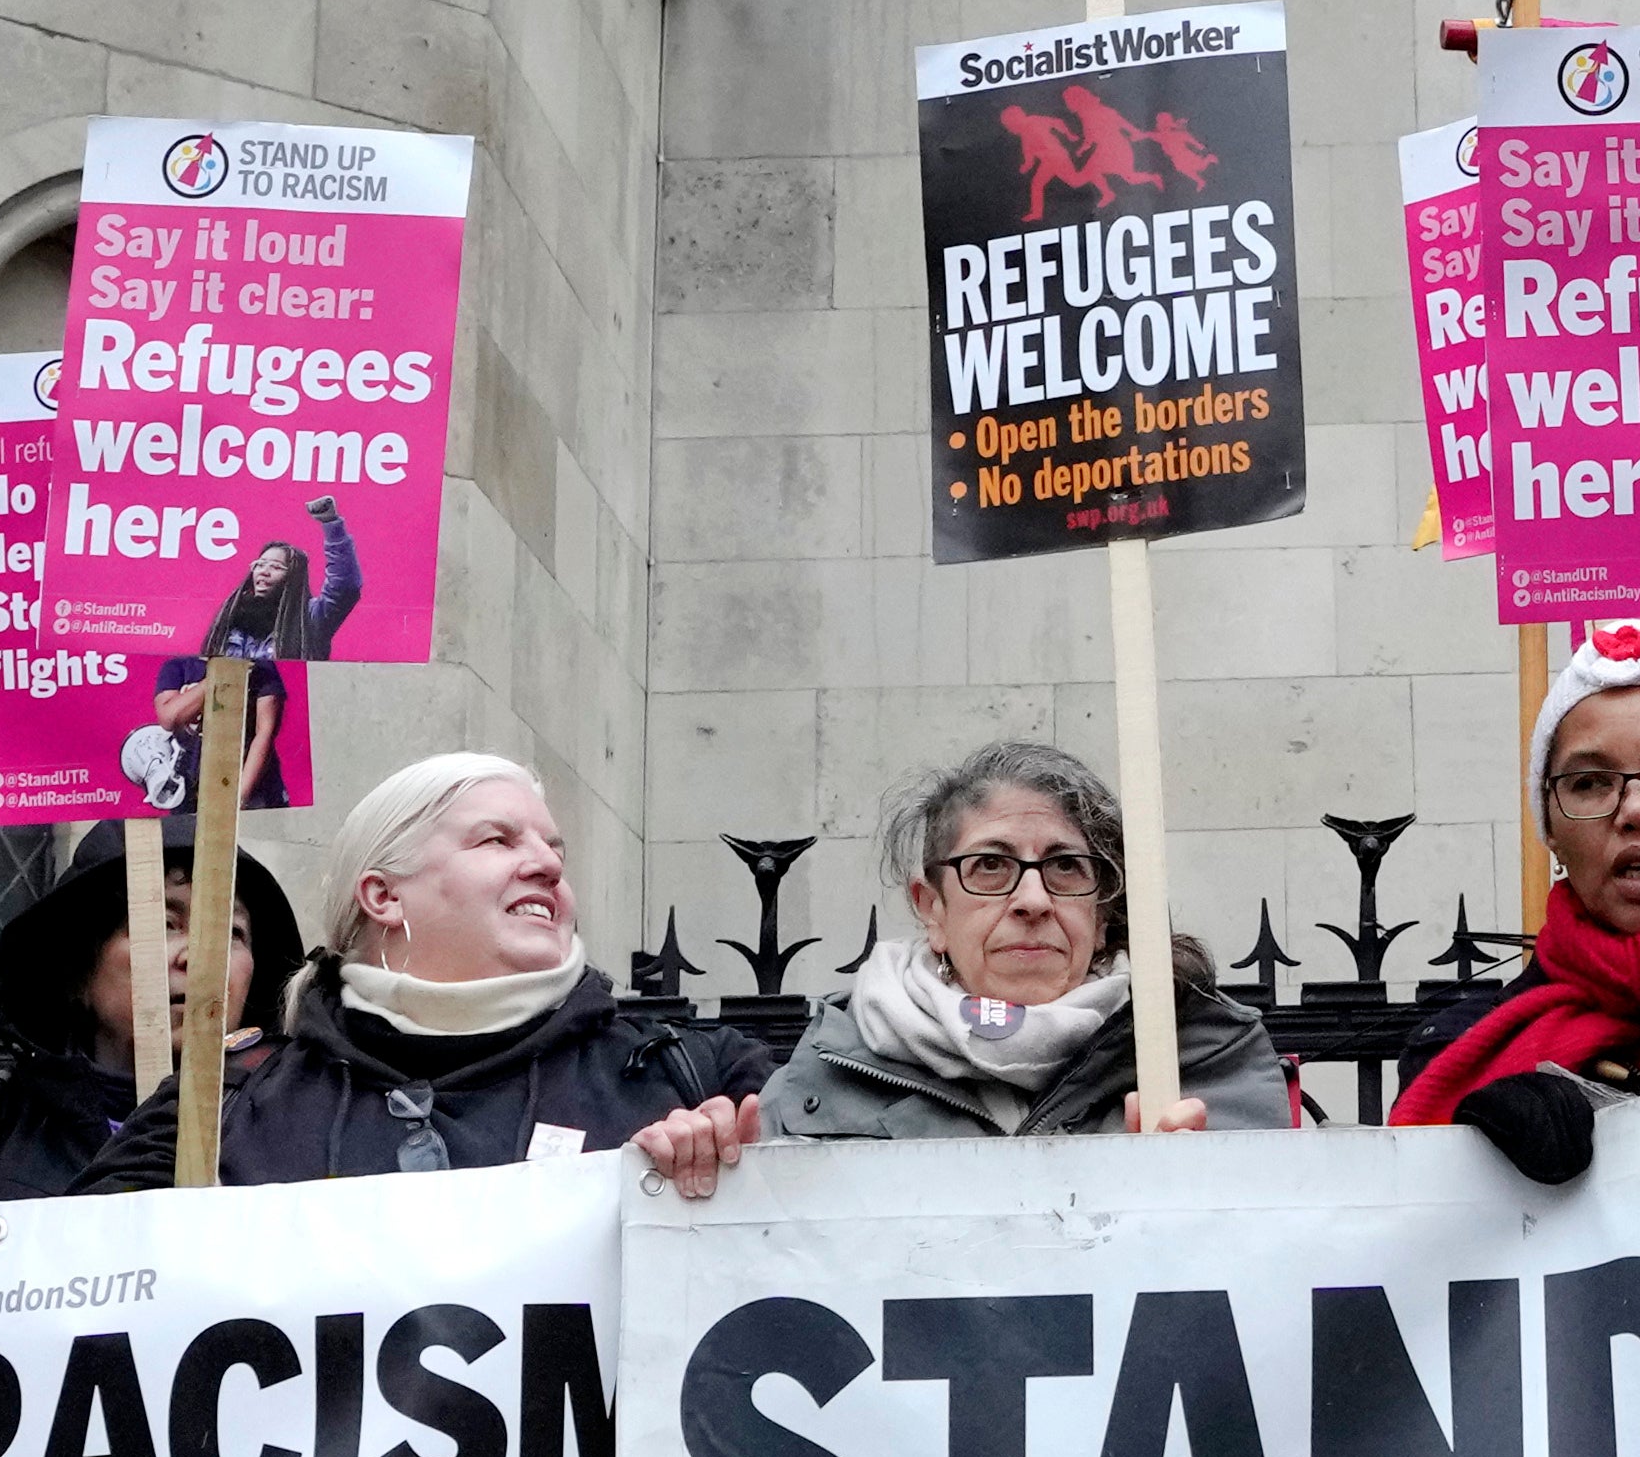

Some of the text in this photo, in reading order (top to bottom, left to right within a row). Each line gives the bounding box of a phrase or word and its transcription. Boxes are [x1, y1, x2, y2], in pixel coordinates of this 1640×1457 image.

[238, 140, 375, 171] STAND UP
[1499, 139, 1589, 197] Say
[238, 170, 387, 201] TO RACISM
[94, 214, 346, 269] Say it loud
[1502, 198, 1592, 256] Say
[87, 264, 177, 321] Say
[190, 270, 225, 313] it
[944, 200, 1277, 330] REFUGEES
[80, 319, 432, 415] Refugees
[943, 285, 1279, 415] WELCOME
[73, 403, 408, 484] welcome
[977, 383, 1269, 466] Open the borders
[979, 438, 1251, 508] No deportations
[64, 483, 239, 560] here
[1066, 499, 1171, 531] swp.org.uk
[1530, 567, 1607, 585] @StandUTR
[1532, 585, 1640, 603] @AntiRacismDay
[71, 600, 148, 619] @StandUTR
[71, 620, 176, 638] @AntiRacismDay
[4, 767, 90, 789] @StandUTR
[4, 788, 121, 809] @AntiRacismDay
